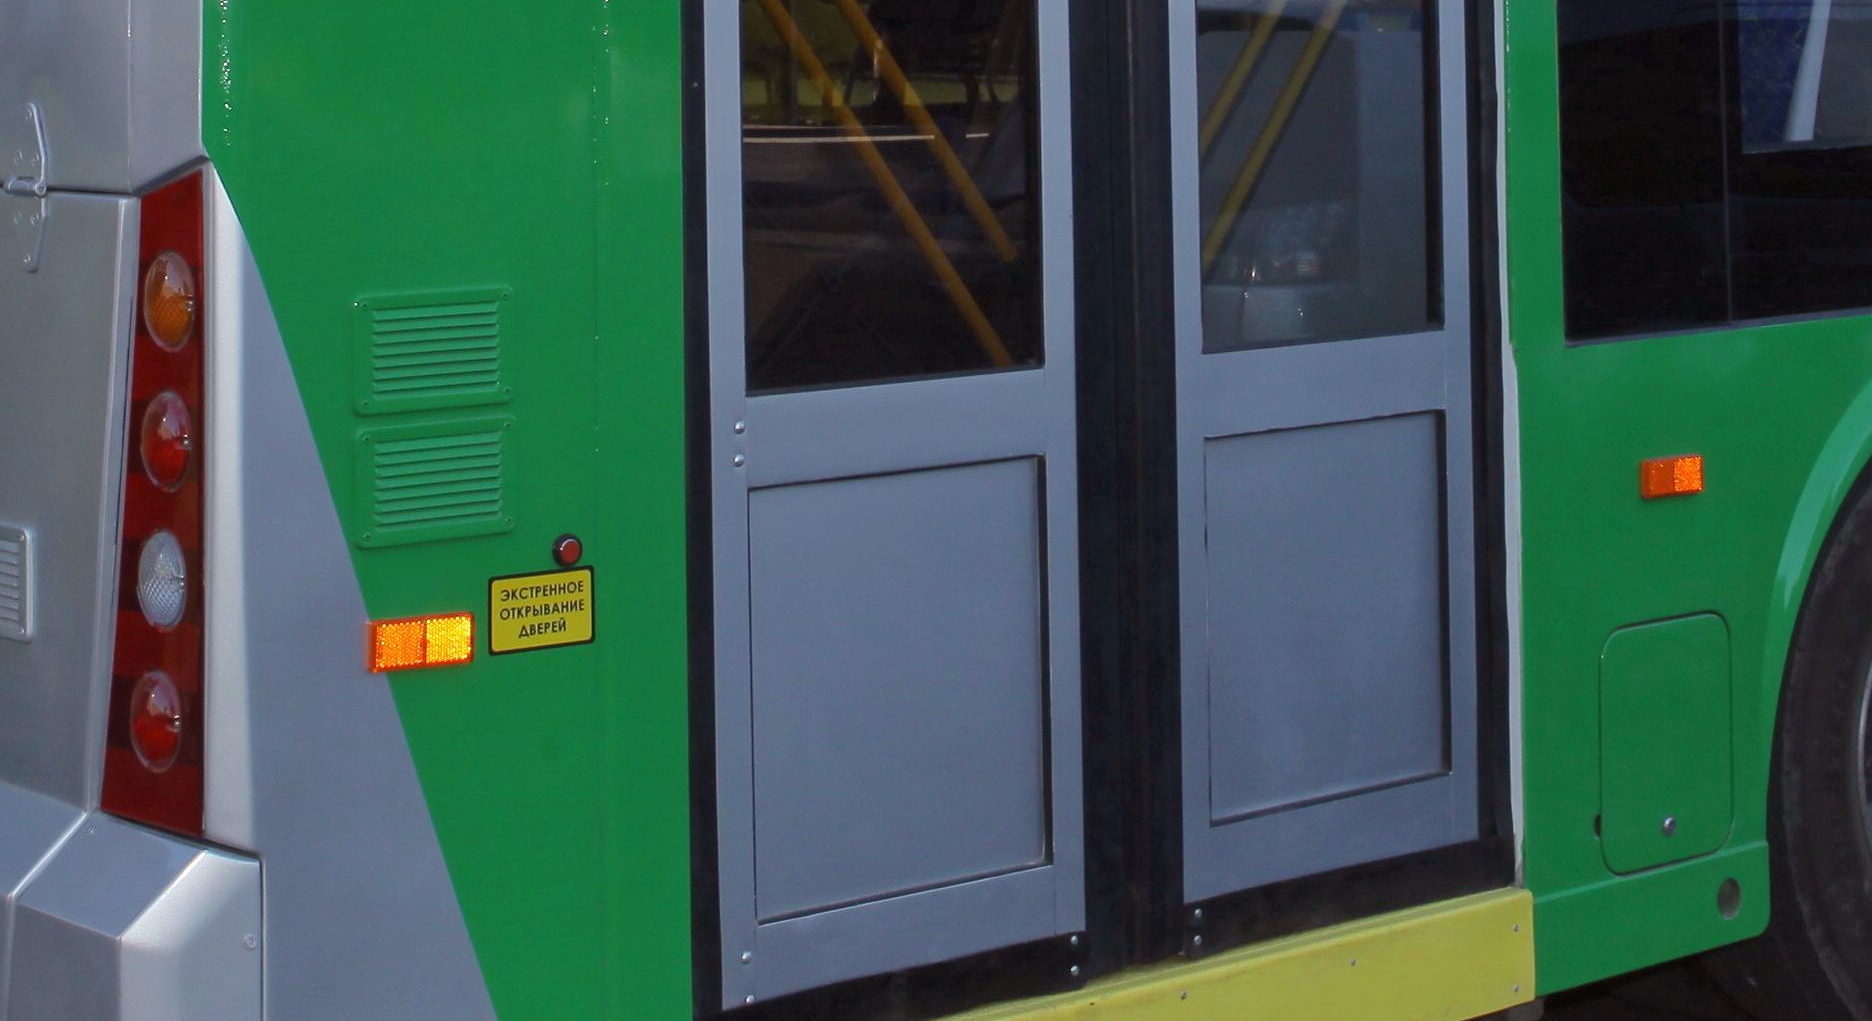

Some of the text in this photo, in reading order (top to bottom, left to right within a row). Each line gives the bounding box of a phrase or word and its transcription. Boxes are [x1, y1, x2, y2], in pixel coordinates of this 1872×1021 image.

[499, 580, 585, 602] ЭКСТРЕННОЕ
[499, 598, 585, 621] ОТКРЫВАНИЕ
[518, 617, 568, 639] ДВЕРЕЙ
